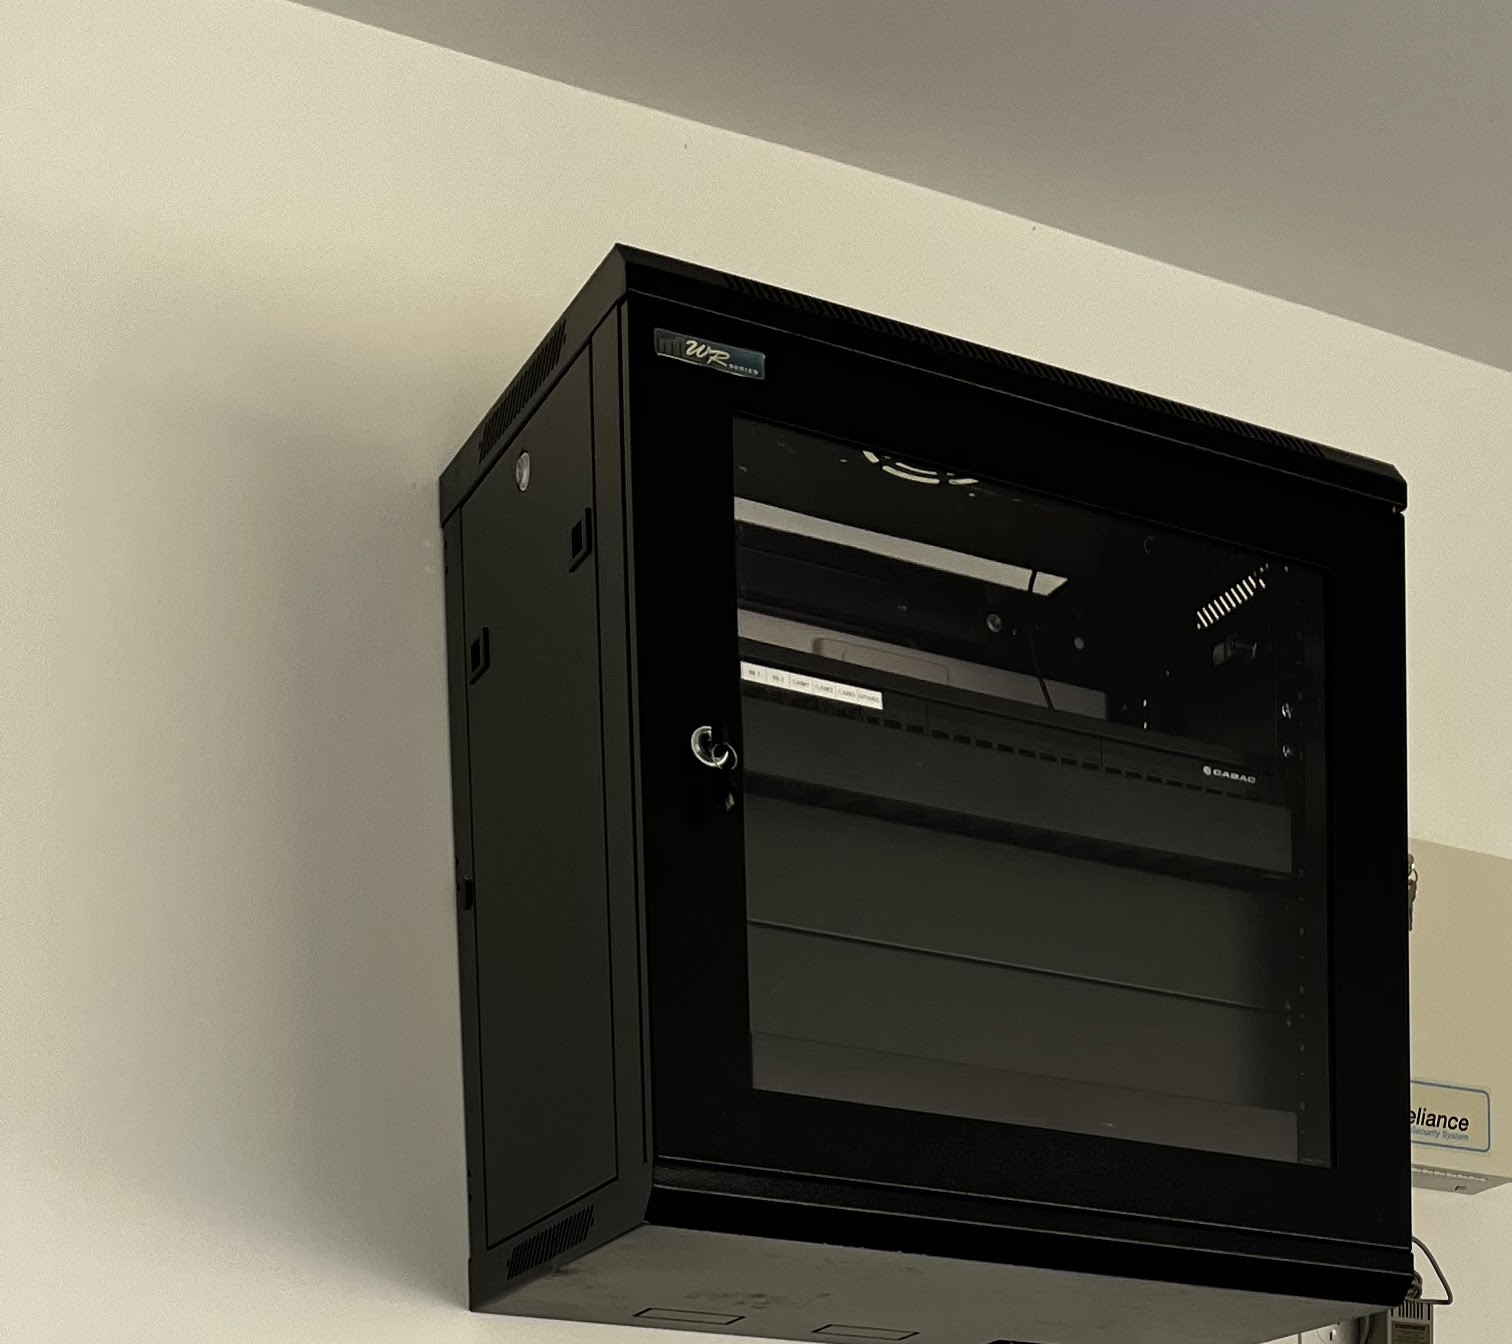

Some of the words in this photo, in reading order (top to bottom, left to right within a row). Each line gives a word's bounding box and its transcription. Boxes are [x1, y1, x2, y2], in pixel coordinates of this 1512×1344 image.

[1213, 769, 1256, 784] CABAC
[1410, 1107, 1469, 1131] eliance
[1442, 1130, 1468, 1141] System
